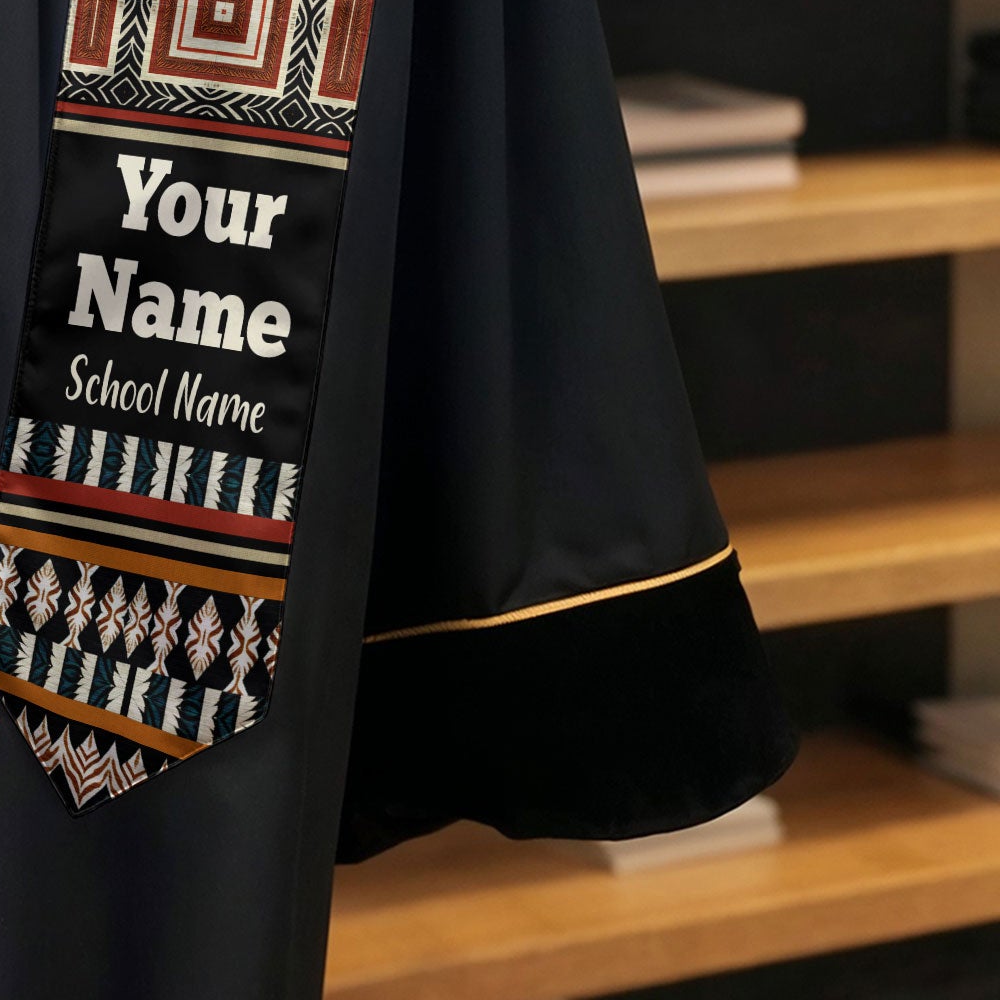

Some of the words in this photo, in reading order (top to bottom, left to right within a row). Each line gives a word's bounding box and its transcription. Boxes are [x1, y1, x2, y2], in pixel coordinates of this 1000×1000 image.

[117, 154, 288, 249] Your
[68, 252, 291, 358] Name
[66, 354, 169, 416] School
[173, 371, 266, 433] Name
